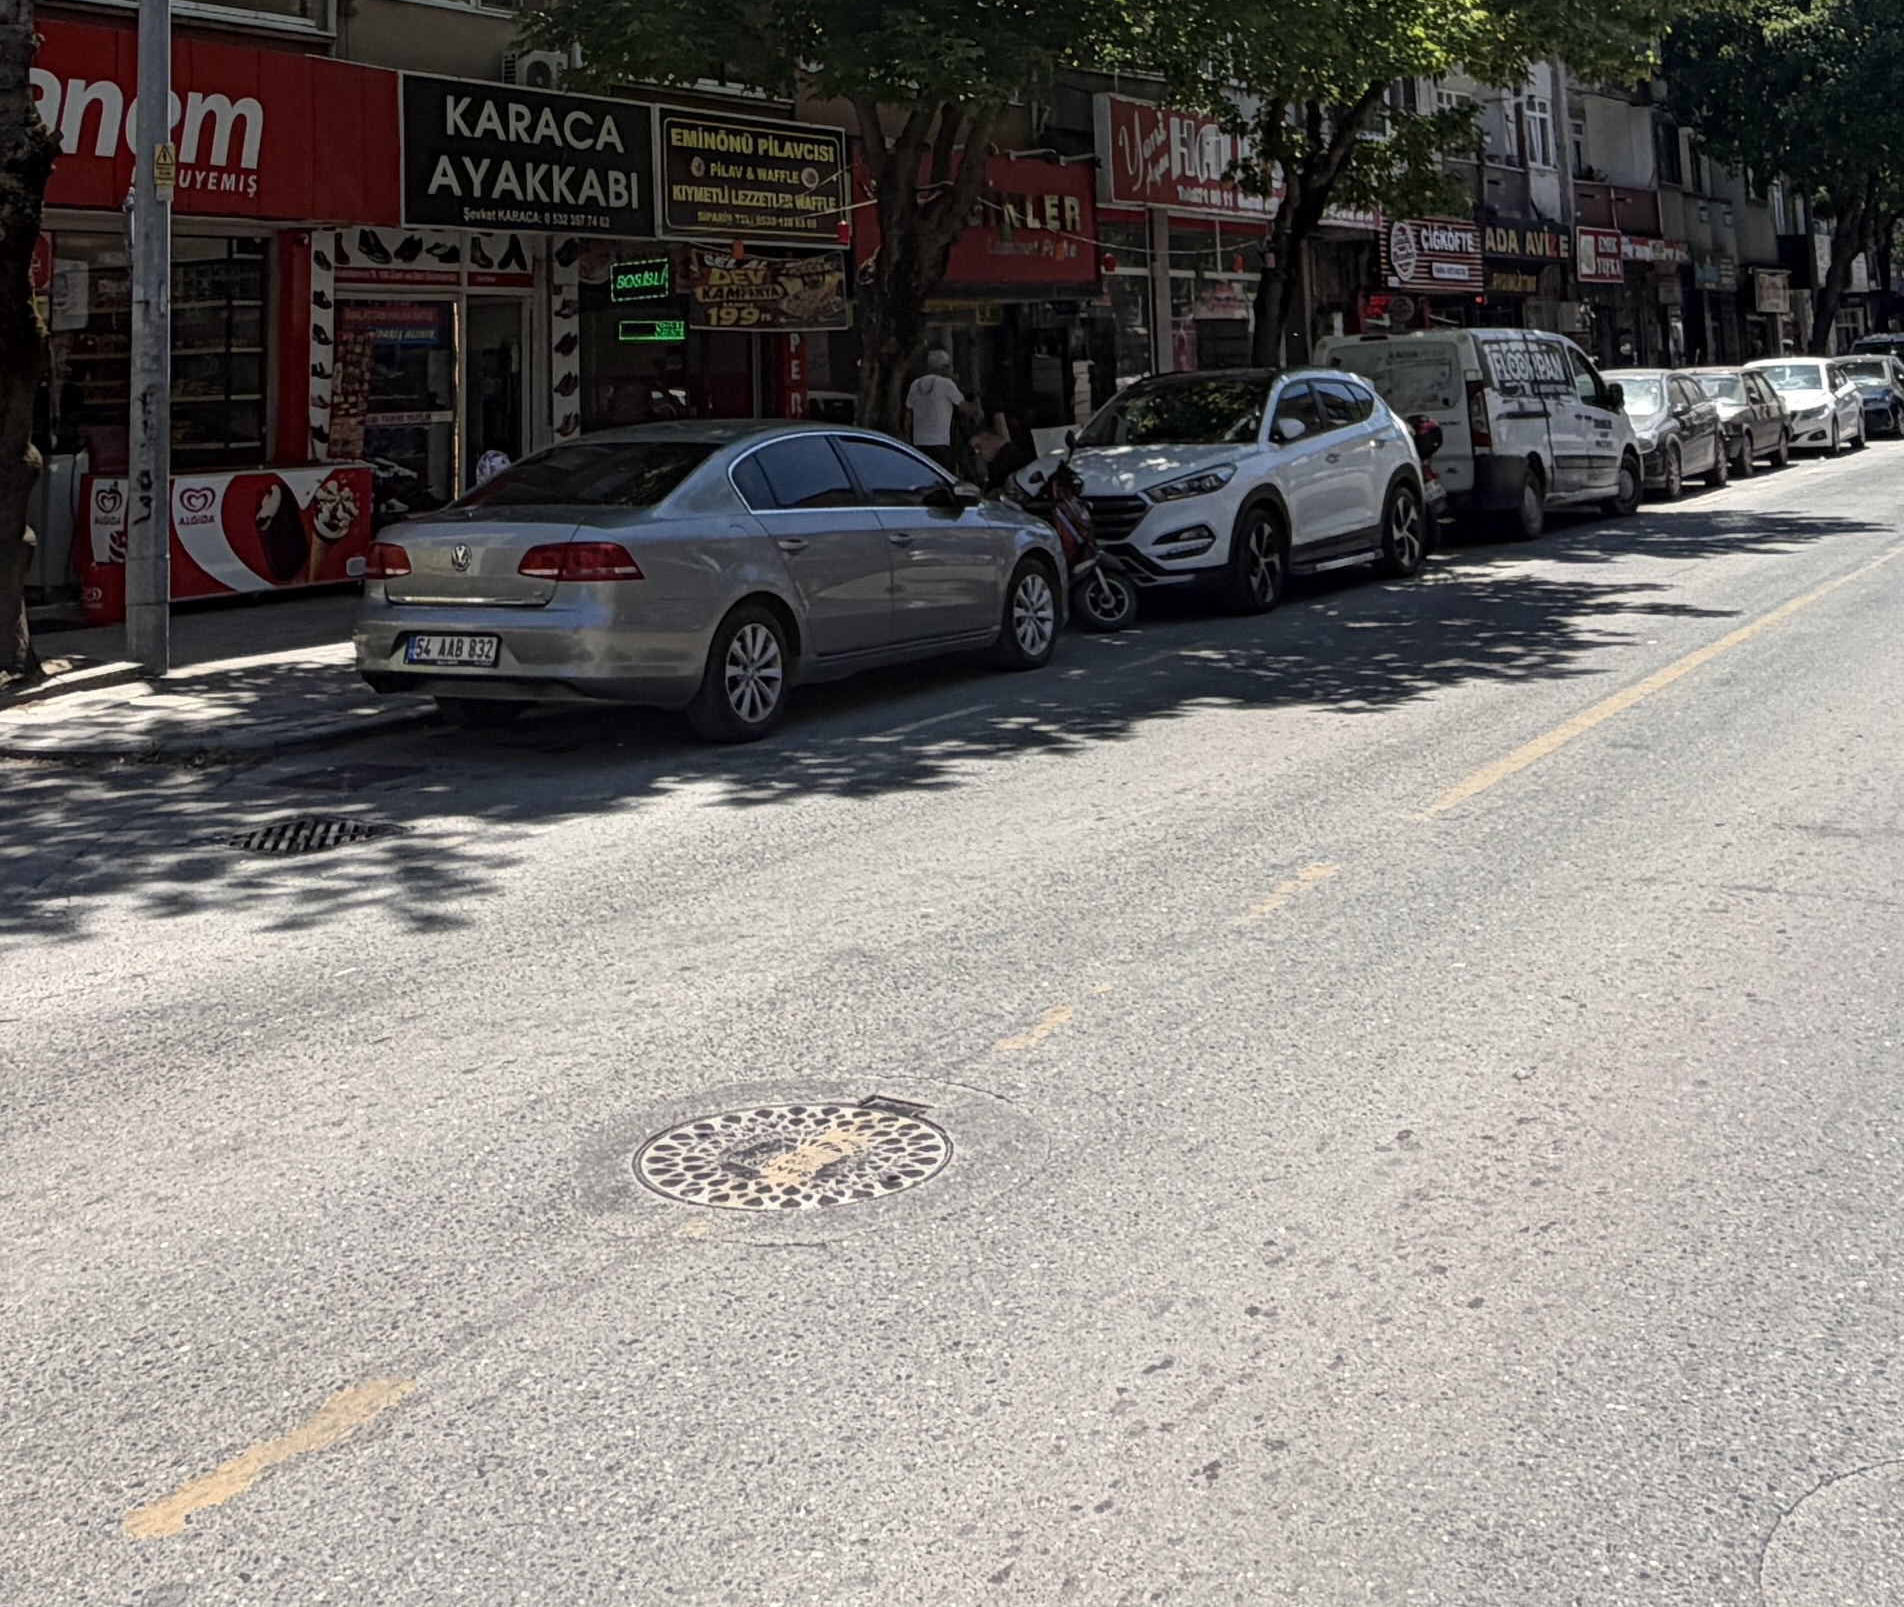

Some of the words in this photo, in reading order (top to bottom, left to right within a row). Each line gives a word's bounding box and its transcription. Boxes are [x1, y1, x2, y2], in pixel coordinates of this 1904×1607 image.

[445, 94, 626, 155] KARACA
[670, 126, 754, 156] EMİNÖNÜ
[757, 134, 835, 163] PİLAVCISI
[426, 154, 640, 210] AYAKKABI
[709, 160, 743, 179] PİLAV
[746, 166, 756, 181] &
[756, 167, 800, 185] WAFFLE
[671, 184, 730, 205] KIYMETLİ
[731, 190, 794, 210] LEZZETLER
[1485, 226, 1521, 254] ADA
[1525, 225, 1569, 259] AVİE
[708, 267, 767, 286] DEV
[706, 306, 761, 326] 199
[415, 637, 432, 658] 54
[438, 638, 465, 659] AAB
[467, 639, 495, 660] 832
